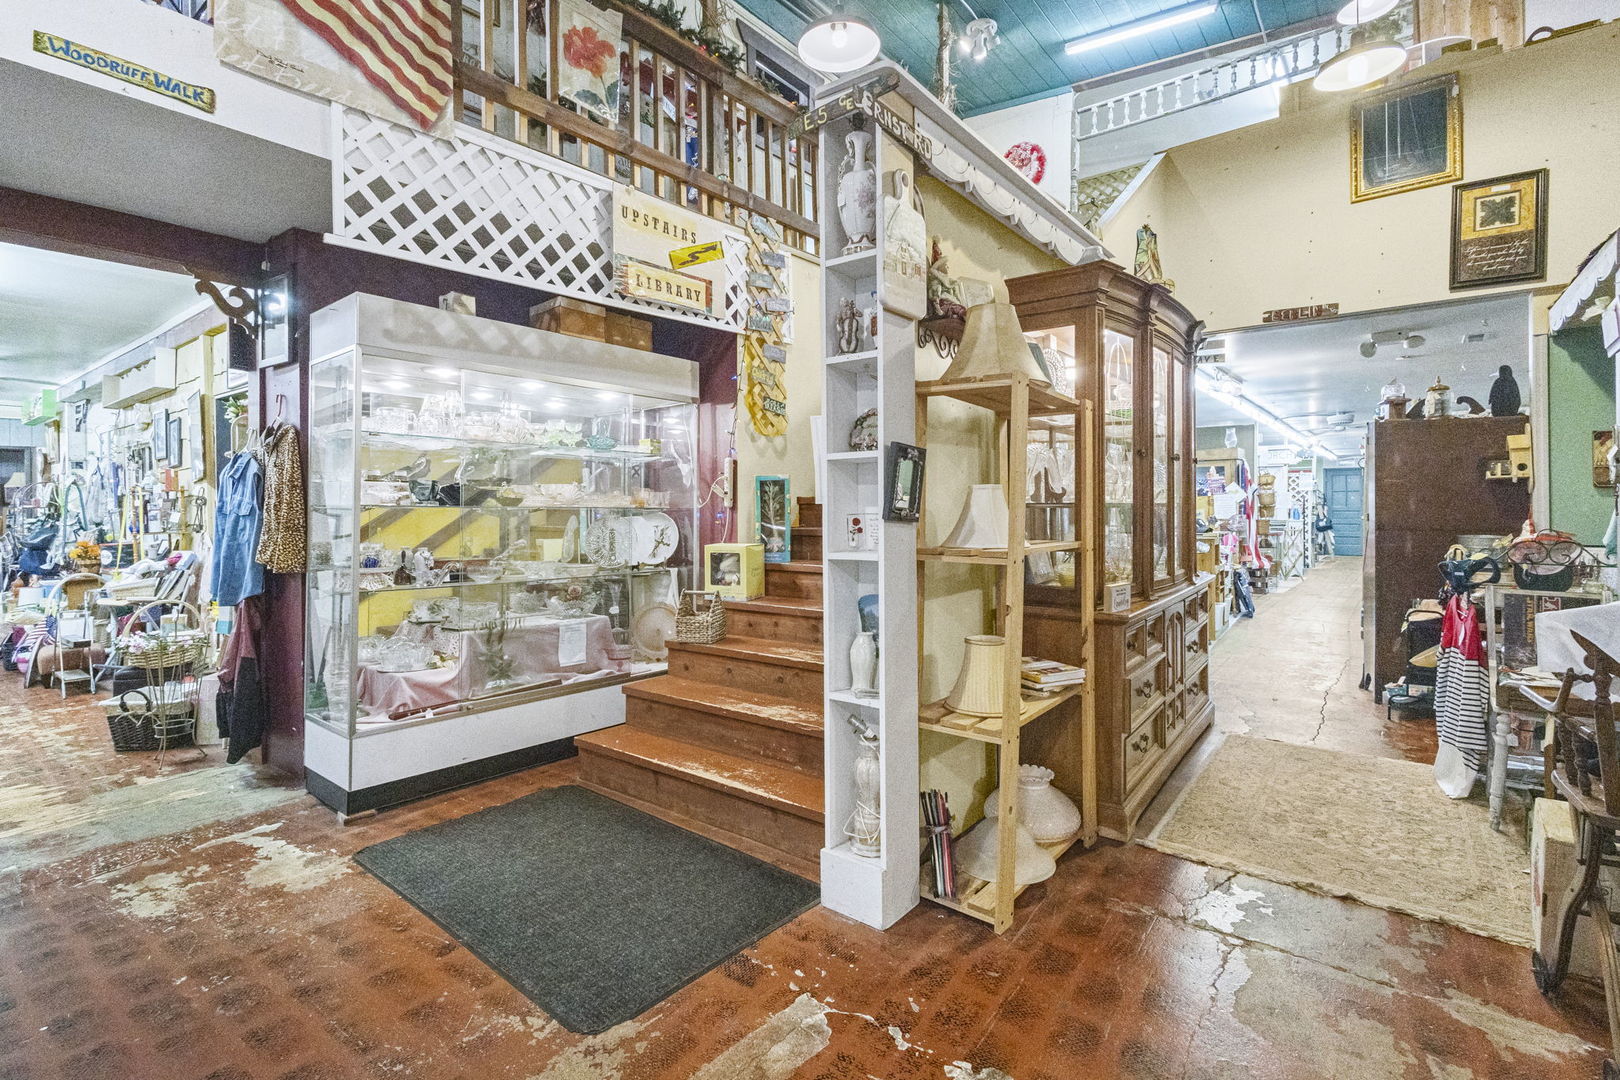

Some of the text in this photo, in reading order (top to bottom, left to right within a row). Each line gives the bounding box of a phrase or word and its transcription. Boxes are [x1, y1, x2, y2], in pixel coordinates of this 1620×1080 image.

[47, 36, 151, 81] WOODRUFF
[153, 72, 205, 103] WALK
[621, 205, 697, 244] UPSTAIRS
[636, 273, 701, 303] LIBRARY
